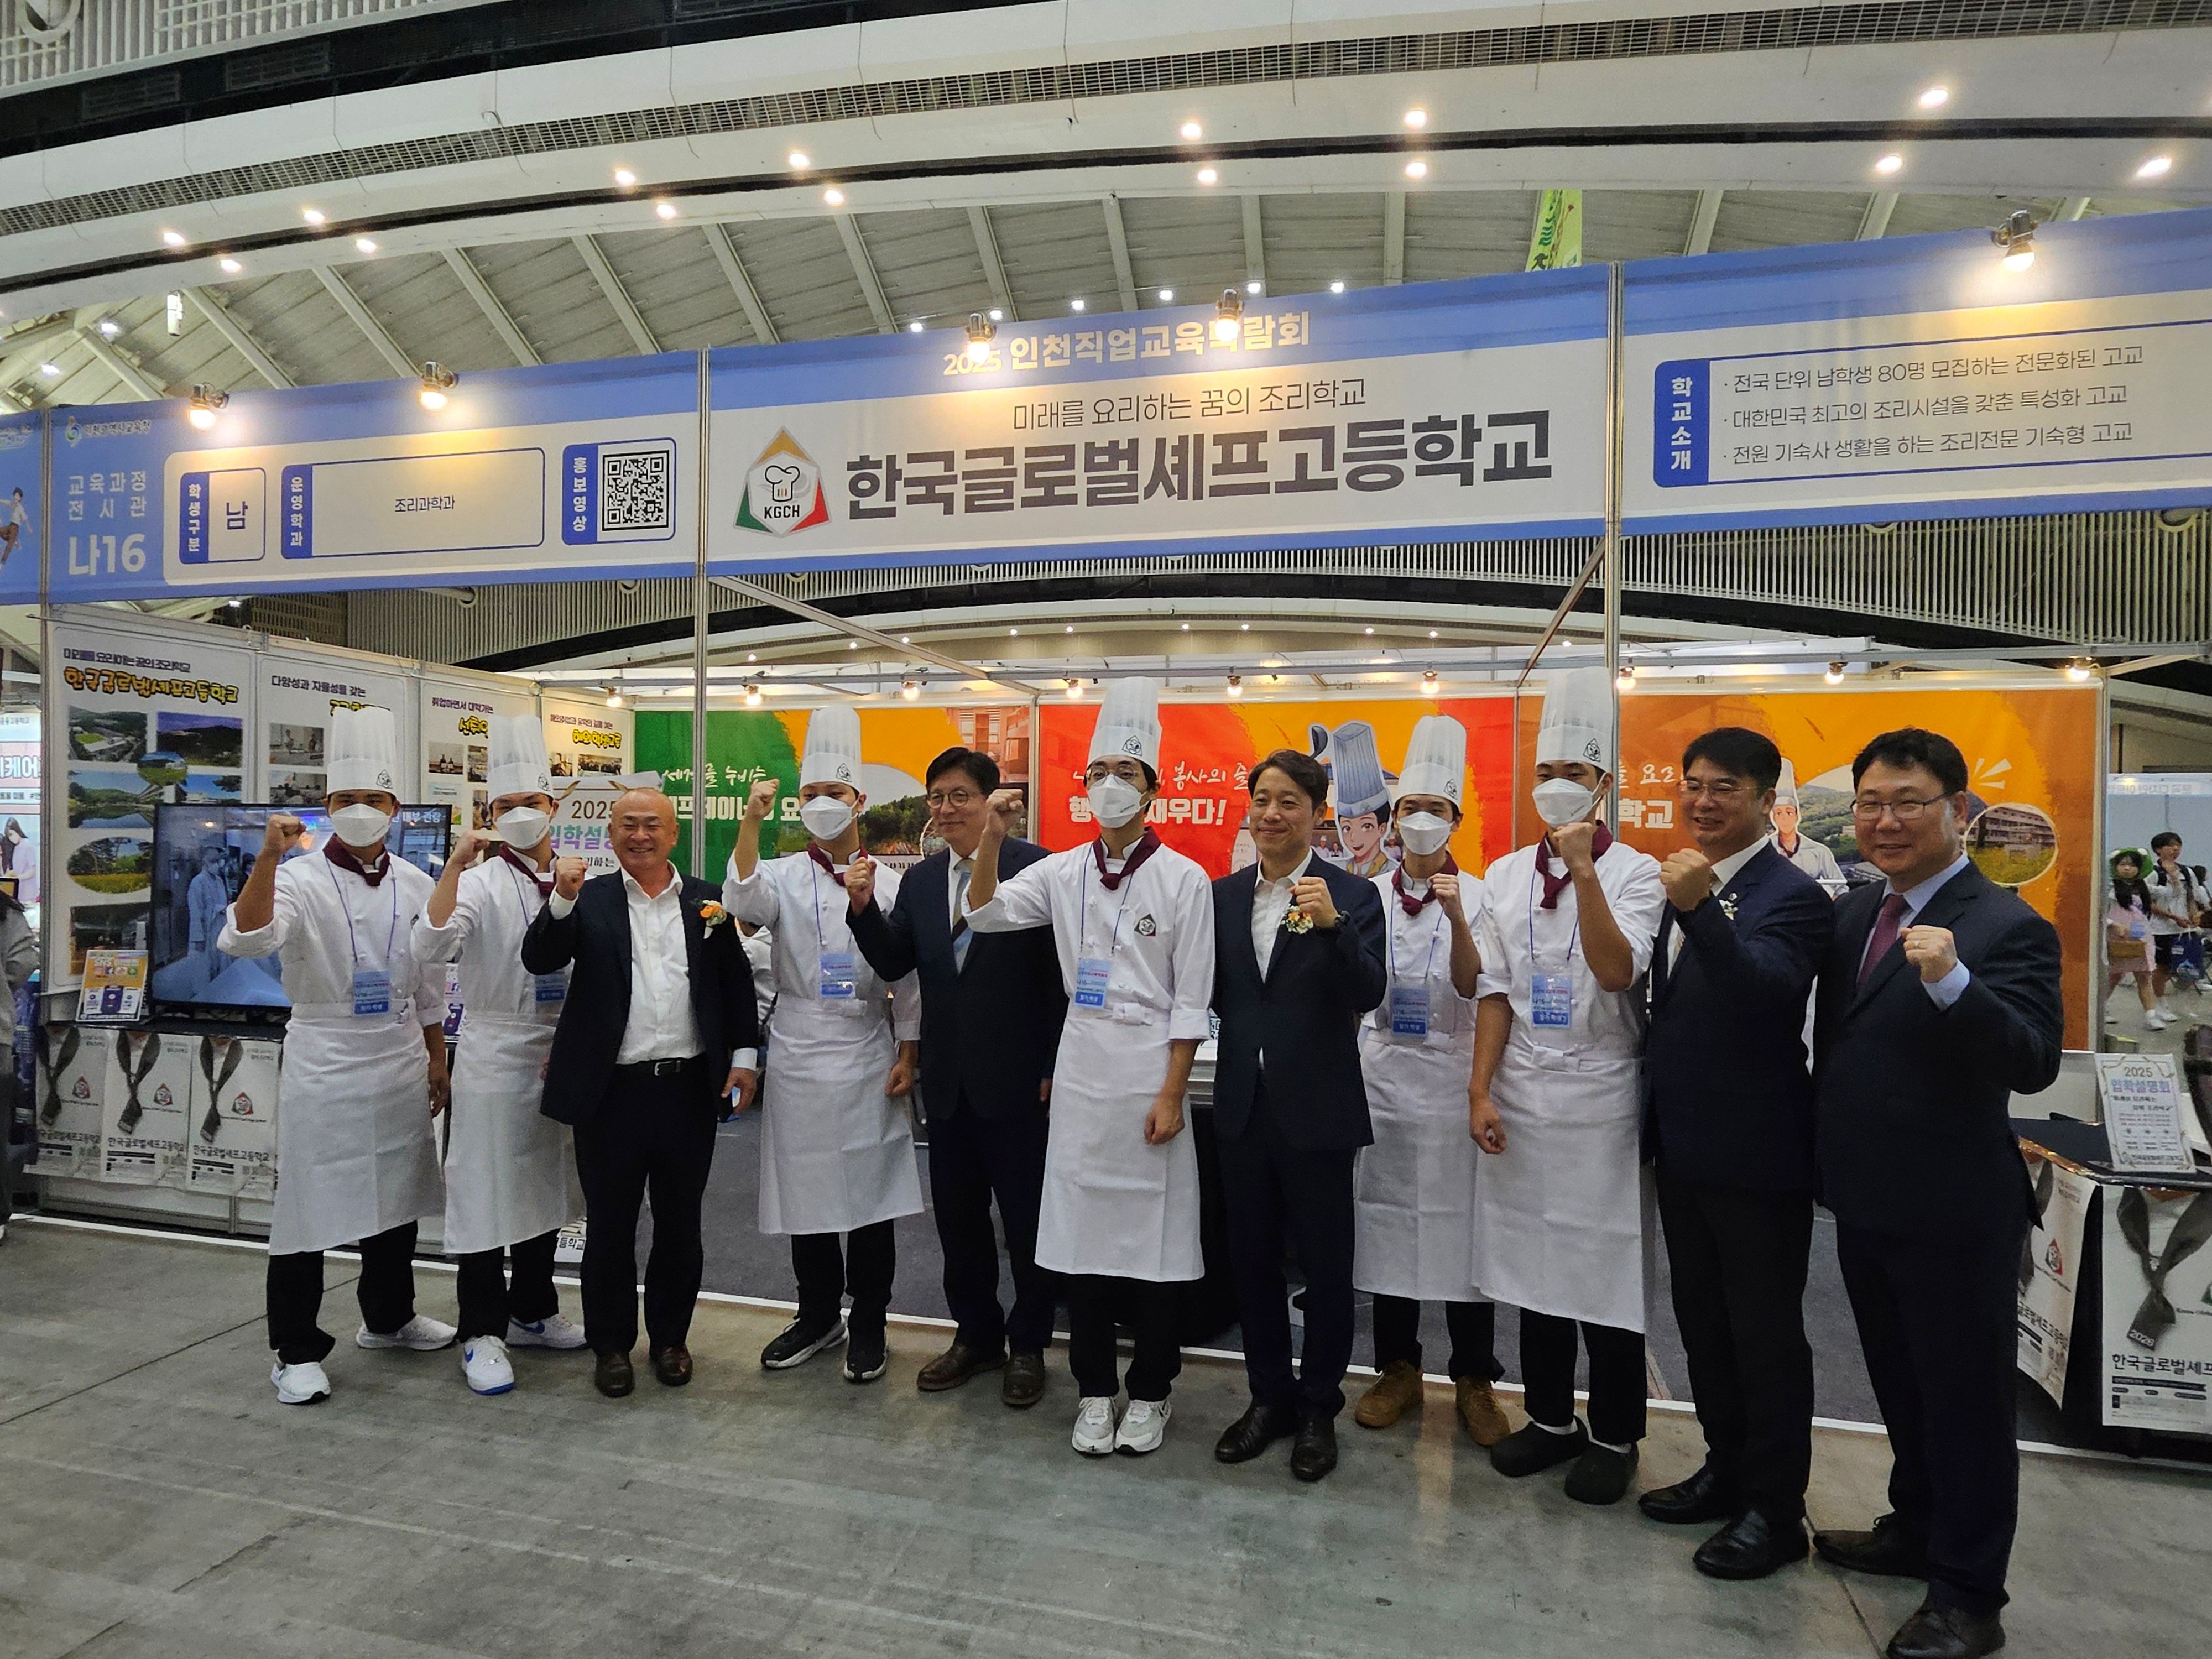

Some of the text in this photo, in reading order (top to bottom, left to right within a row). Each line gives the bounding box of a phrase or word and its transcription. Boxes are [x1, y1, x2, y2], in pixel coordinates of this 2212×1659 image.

[1010, 311, 1310, 370] 인천직업교육람회
[1734, 346, 2143, 393] 전국 단위 남학생 80명 모집하는 전문화된 고교
[1014, 378, 1365, 430] 미래를 요리하는 꿈의 조리학교
[1671, 377, 1693, 470] 학교소개
[1734, 385, 2127, 428] 대한민국 최고의 조리시설을 갖춘 특성화 고교
[1734, 422, 2132, 465] 전원 기숙사 생활을 하는 조리전문 기숙형 고교
[68, 471, 146, 495] 교육과정
[847, 410, 1552, 520] 한국글로벌셰프고등학교
[290, 477, 303, 547] 운영학과
[394, 495, 455, 512] 조리과학과
[573, 457, 587, 532] 홍보영상
[764, 504, 800, 520] KGCH
[188, 483, 201, 551] 학생구분
[226, 502, 248, 530] 남
[69, 533, 146, 575] 나16
[272, 675, 366, 698] 다양성과 자율성을 갖는
[1173, 761, 1226, 790] 봉사의
[1069, 796, 1095, 823] 행
[2110, 1079, 2171, 1093] 입학설명회
[2124, 1066, 2153, 1077] 2025
